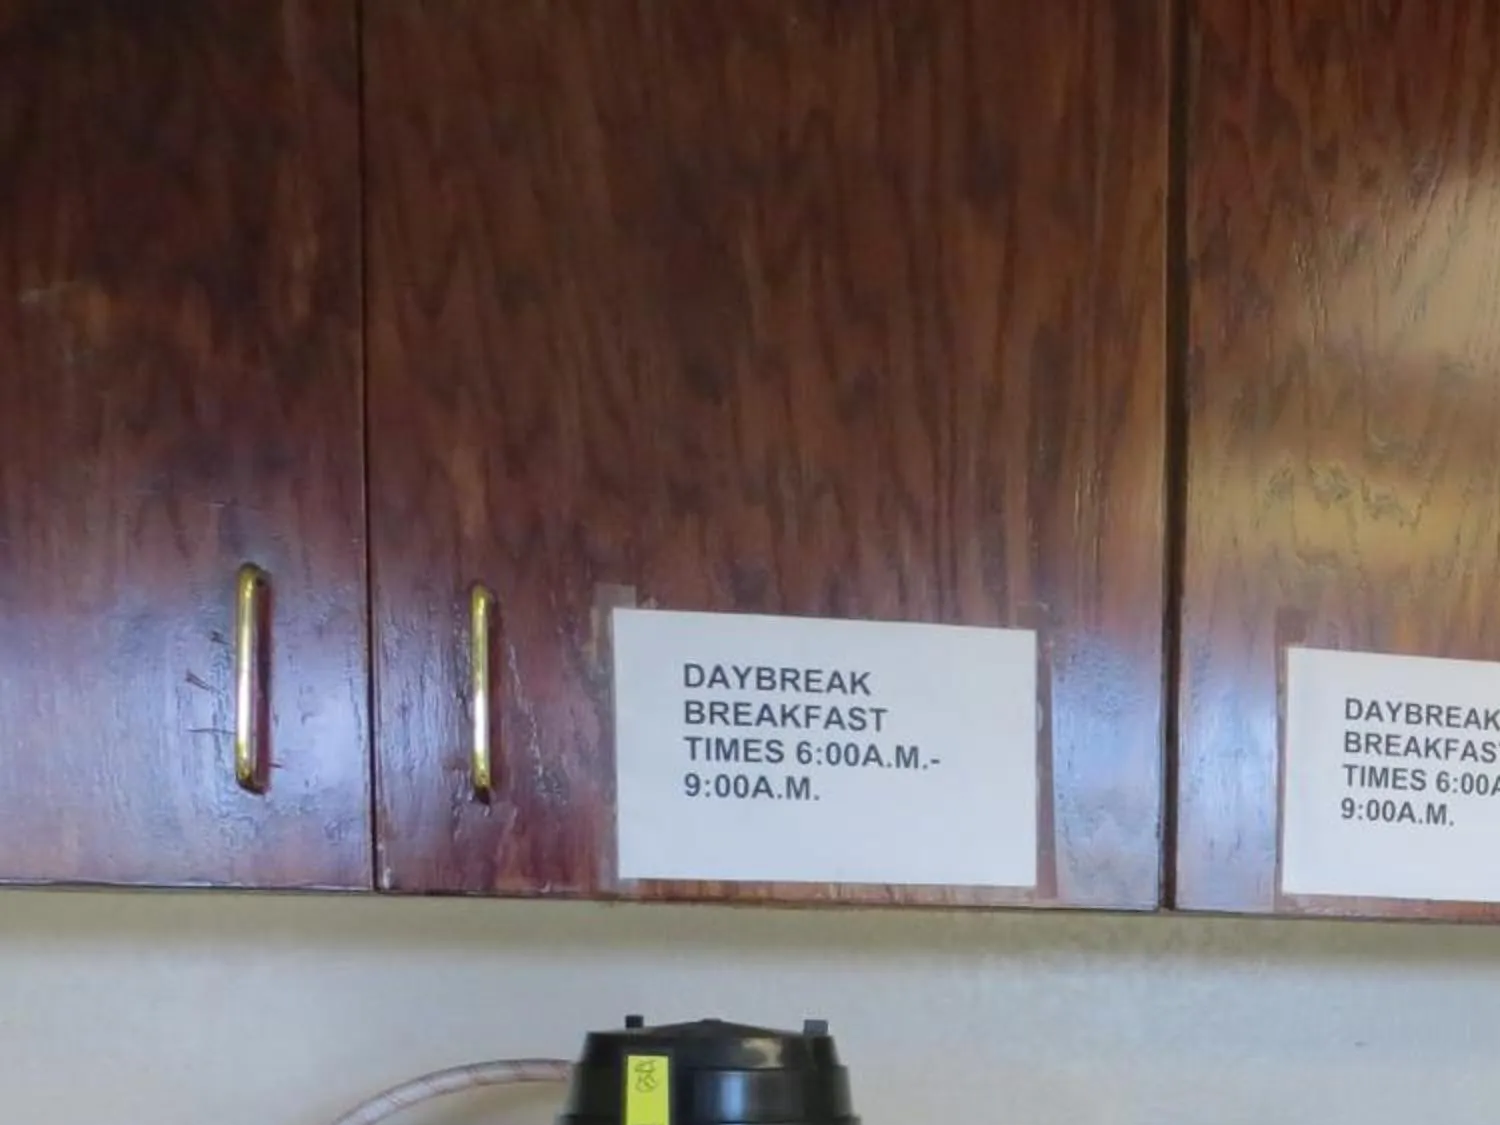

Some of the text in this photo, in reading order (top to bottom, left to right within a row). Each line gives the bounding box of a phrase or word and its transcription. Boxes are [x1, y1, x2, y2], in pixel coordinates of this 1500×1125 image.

[683, 662, 872, 696] DAYBREAK
[684, 699, 888, 732] BREAKFAST
[683, 736, 941, 770] TIMES 6:00A.M.-
[683, 772, 820, 801] 9:00A.M.
[1342, 763, 1427, 792] TIMES
[1341, 797, 1455, 827] 9:00A.M.
